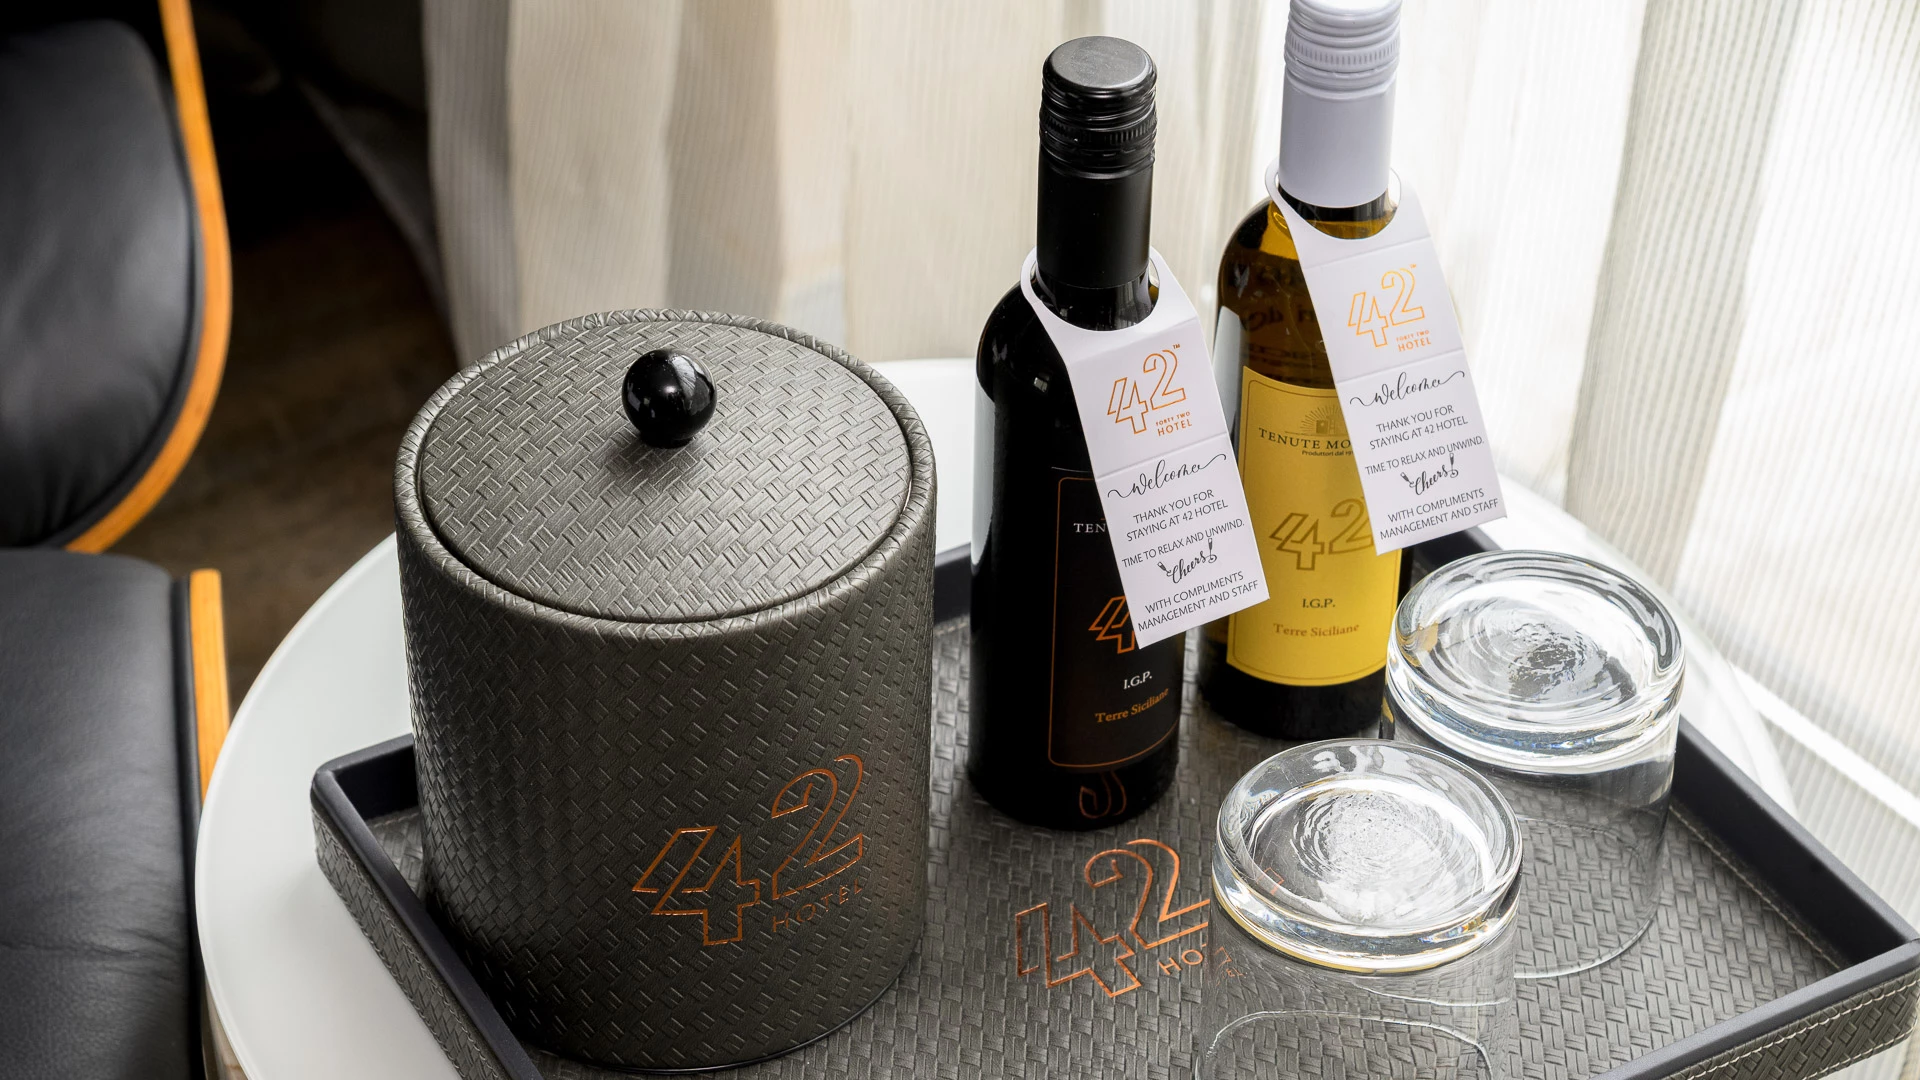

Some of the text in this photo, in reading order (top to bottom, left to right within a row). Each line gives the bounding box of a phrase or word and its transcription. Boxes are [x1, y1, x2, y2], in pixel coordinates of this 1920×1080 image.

[1347, 267, 1426, 349] 42
[1395, 329, 1430, 343] FORTY TWO
[1397, 337, 1432, 352] HOTEL
[1107, 349, 1187, 435] 42
[1155, 411, 1191, 427] FORTY TWO
[1157, 418, 1193, 437] HOTEL
[1369, 415, 1469, 450] STAYING AT 42 HOTEL
[1375, 404, 1455, 433] THANK YOU FOR
[1258, 427, 1352, 450] TENUTE MO
[1364, 435, 1485, 475] TIME TO RELAX AND UNWIND.
[1126, 499, 1229, 542] STAYING AT 42 HOTEL
[1132, 489, 1215, 524] THANK YOU FOR
[1379, 497, 1498, 540] MANAGEMENT AND STAFF
[1387, 487, 1485, 523] WITH COMPLIMENTS
[1073, 522, 1107, 534] TEN
[1121, 518, 1245, 568] TIME TO RELAX AND UNWIND.
[1268, 496, 1375, 571] 42
[1137, 579, 1258, 632] MANAGEMENT AND STAFF
[1144, 570, 1244, 614] WITH COMPLIMENTS
[1301, 598, 1336, 609] I.G.P.
[1088, 595, 1136, 655] 4
[1273, 622, 1360, 638] Terre Siciliane
[1122, 670, 1153, 690] I.G.P.
[1095, 687, 1170, 724] Terre Siciliane
[631, 753, 864, 946] 42
[772, 878, 863, 933] HOTEL
[1015, 838, 1211, 998] 42
